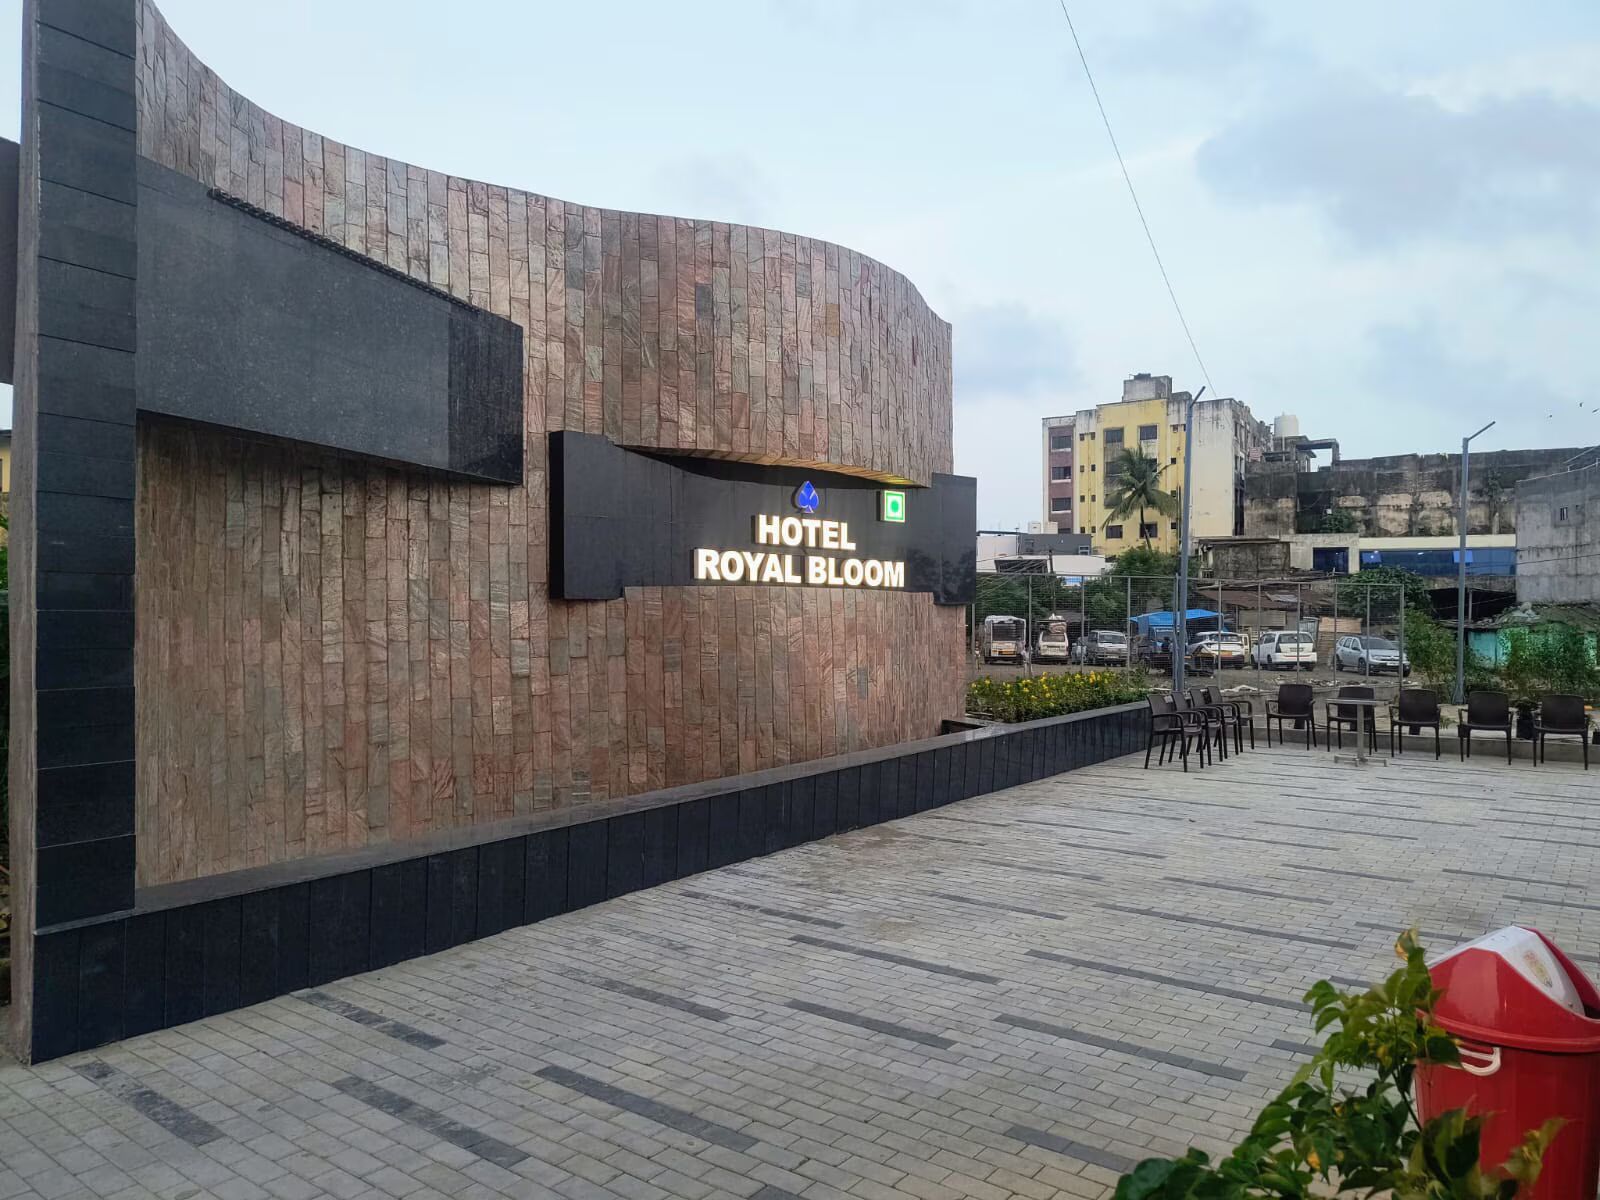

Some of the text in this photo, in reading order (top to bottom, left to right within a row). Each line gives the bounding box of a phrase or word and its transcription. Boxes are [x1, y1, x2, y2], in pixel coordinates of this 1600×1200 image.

[757, 514, 856, 550] HOTEL
[695, 548, 905, 588] ROYAL BLOOM
